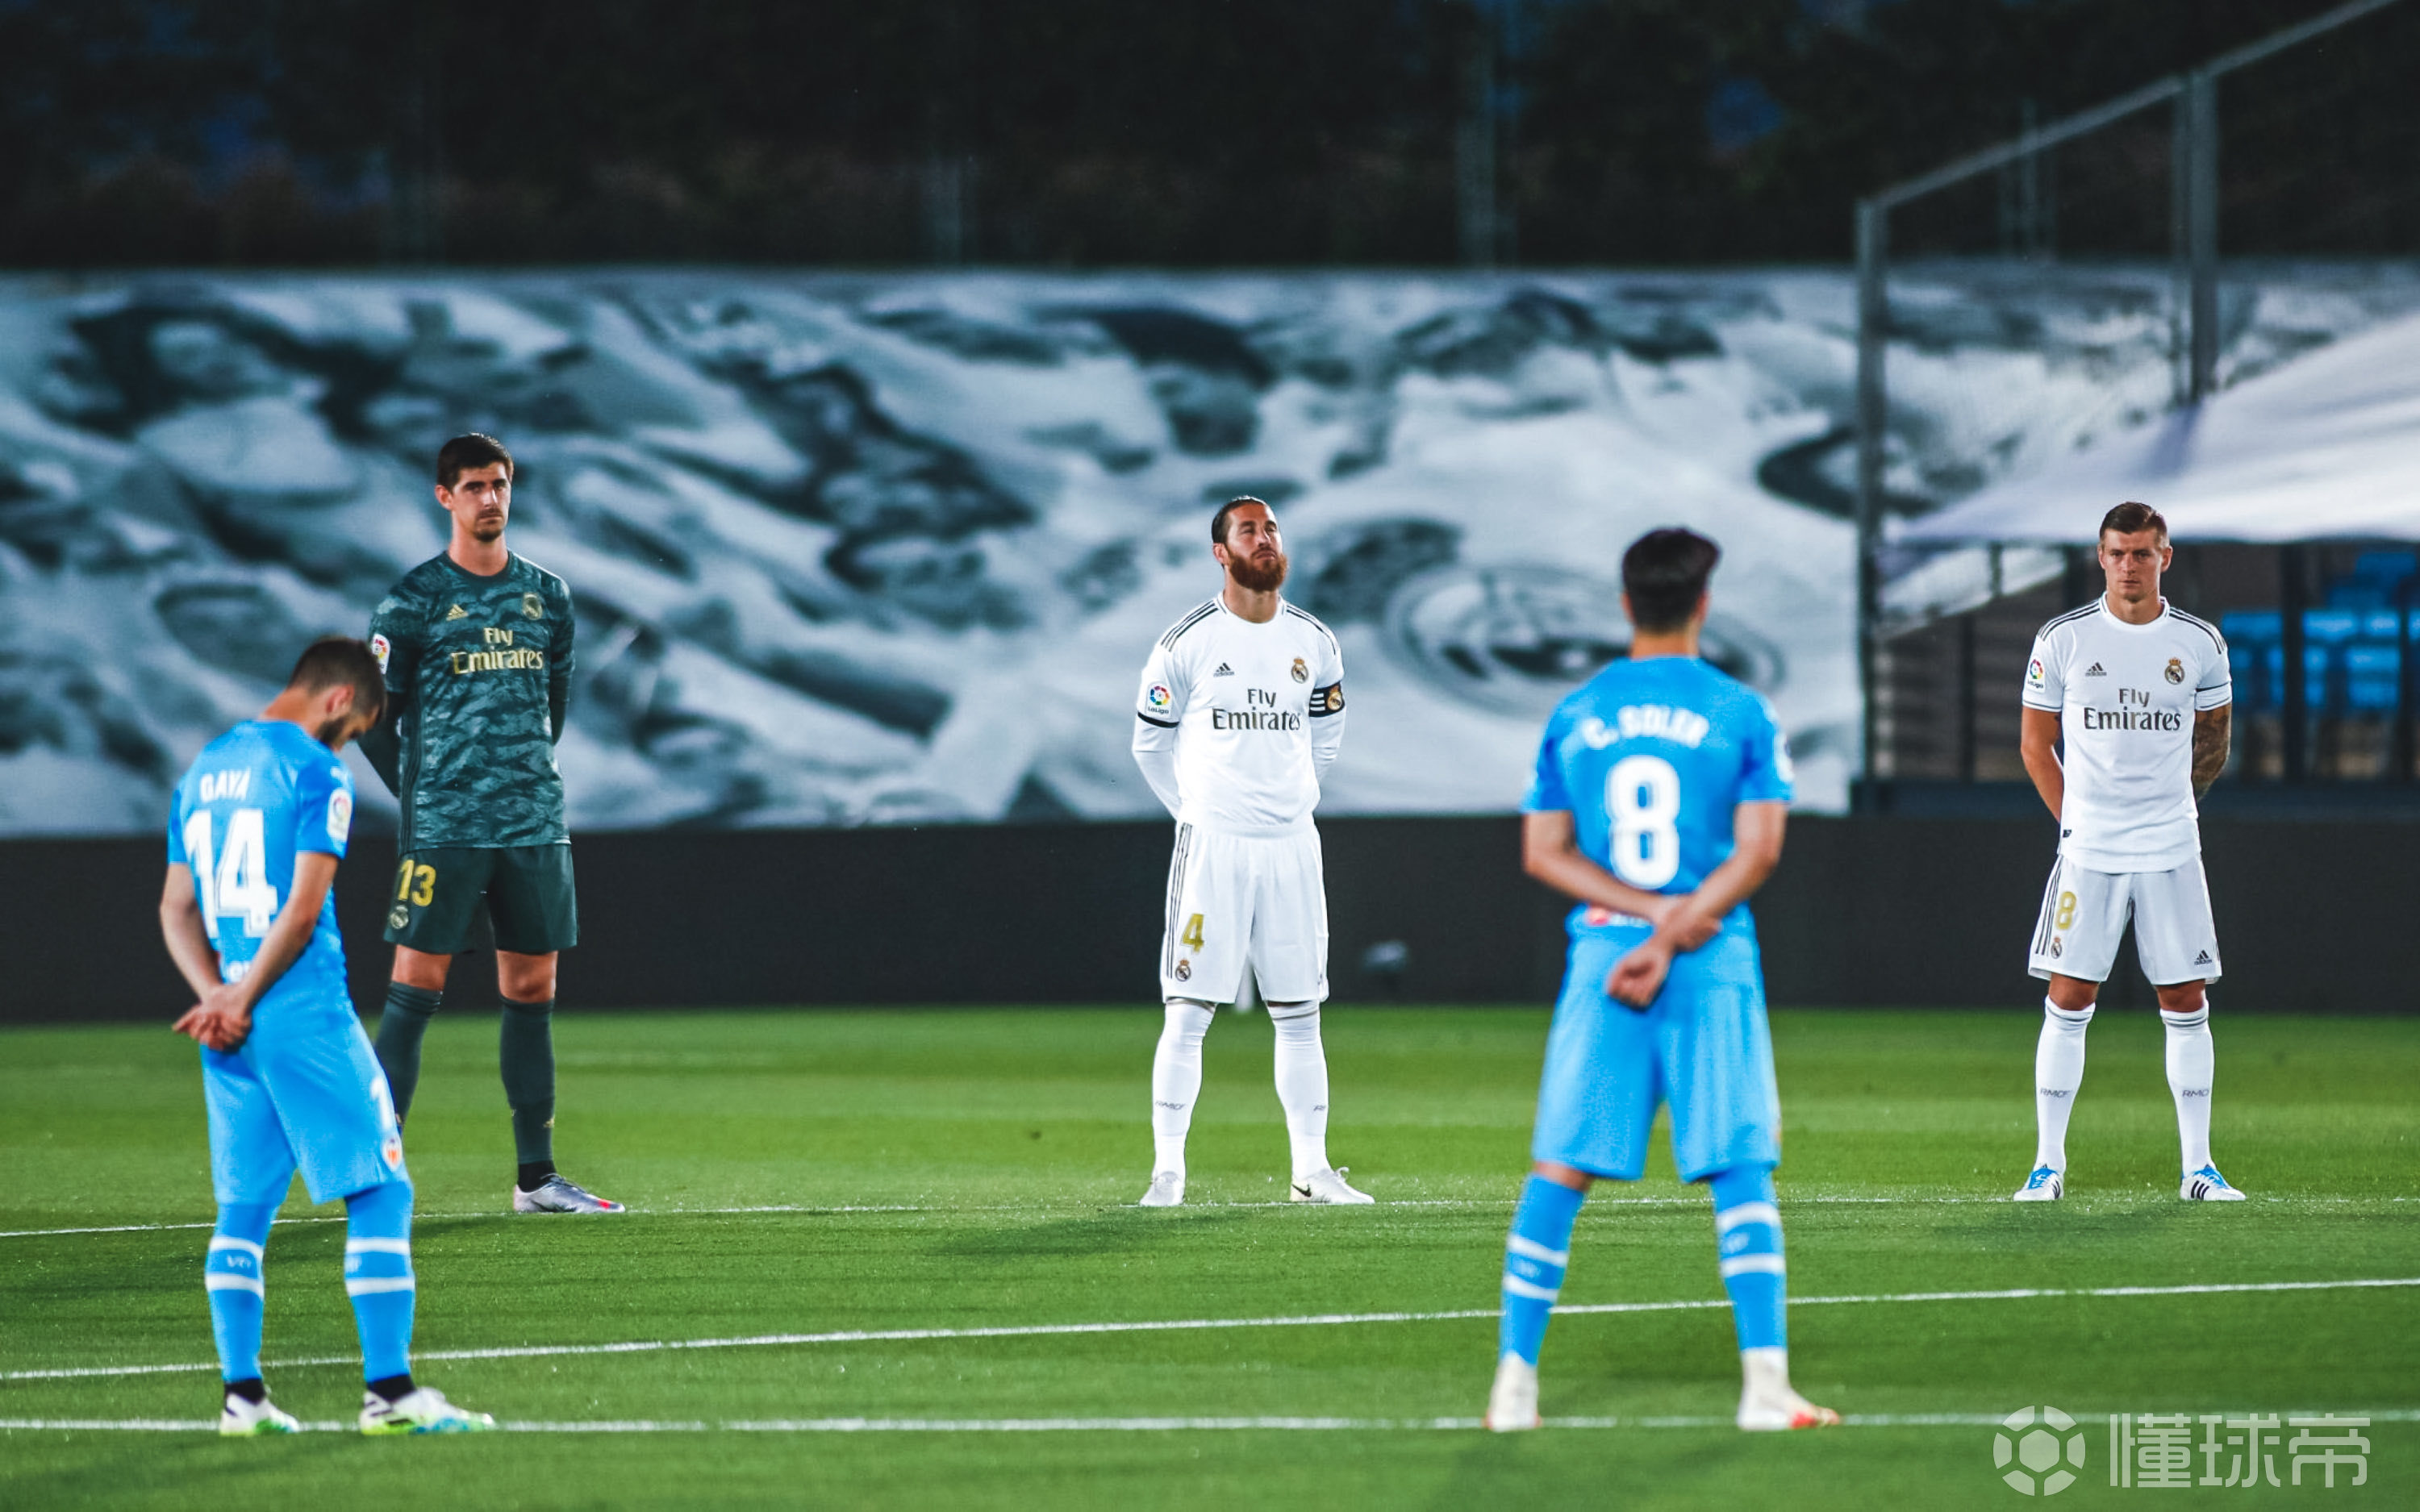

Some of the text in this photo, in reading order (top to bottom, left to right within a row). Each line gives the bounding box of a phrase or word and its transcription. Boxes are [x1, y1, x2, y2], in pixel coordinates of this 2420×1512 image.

[483, 627, 513, 646] Fly
[450, 646, 544, 674] Emirates
[1247, 689, 1276, 707] Fly
[2119, 689, 2150, 707] Fly
[1212, 706, 1300, 730] Emirates
[2084, 706, 2181, 731] Emirates
[1604, 755, 1680, 889] 8
[185, 808, 277, 938] 14
[398, 859, 436, 906] 13
[2056, 890, 2076, 931] 8
[1181, 913, 1204, 953] 4
